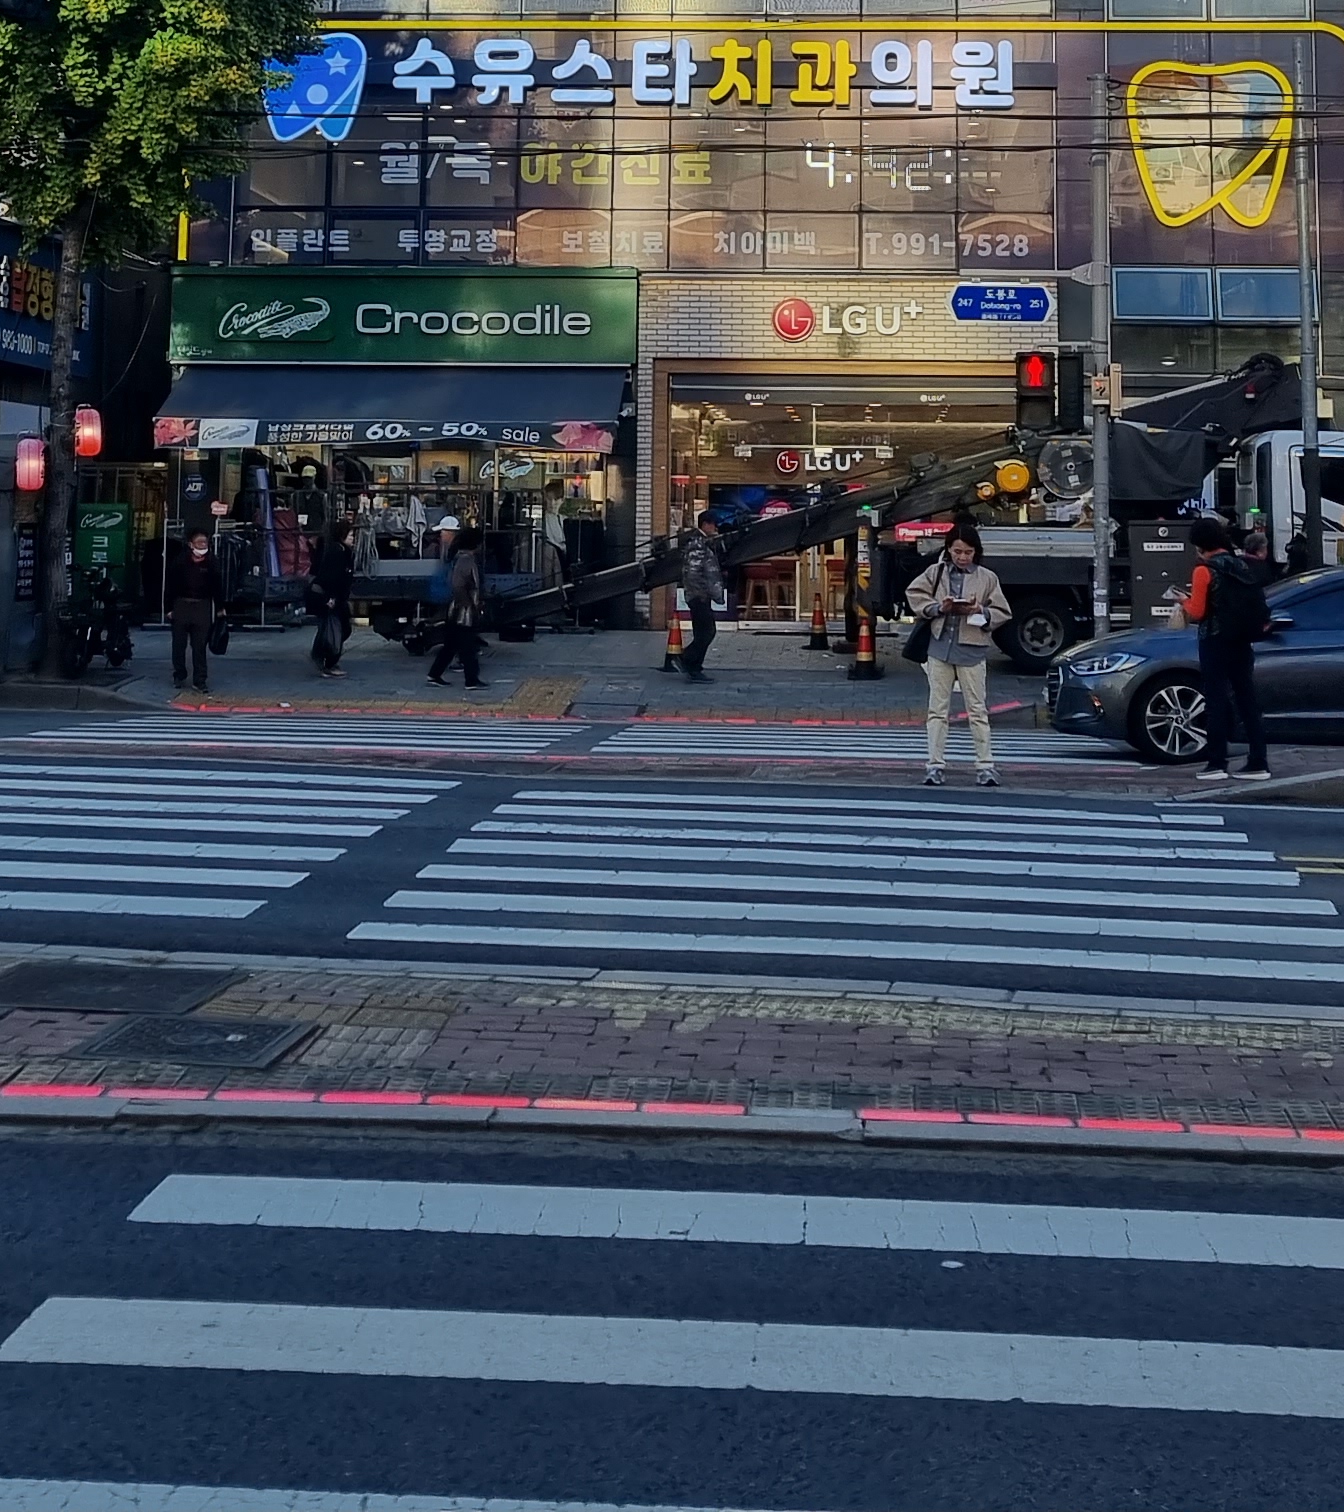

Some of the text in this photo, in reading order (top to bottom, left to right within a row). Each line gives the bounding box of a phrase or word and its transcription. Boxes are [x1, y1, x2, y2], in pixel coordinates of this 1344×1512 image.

[392, 37, 1016, 110] 수유스타치과의원
[520, 141, 713, 185] 야간진료
[251, 229, 350, 253] 임플란트
[398, 229, 498, 253] 투명교정
[561, 229, 665, 255] 보철치료
[714, 229, 817, 254] 치아미백
[957, 298, 973, 306] 247
[1029, 299, 1044, 308] 251
[984, 289, 1017, 300] 도봉로
[218, 300, 593, 339] Crocodile Crocodile
[365, 422, 411, 440] 60%
[441, 422, 488, 438] 50%
[501, 426, 541, 444] sale
[186, 482, 204, 493] ADT
